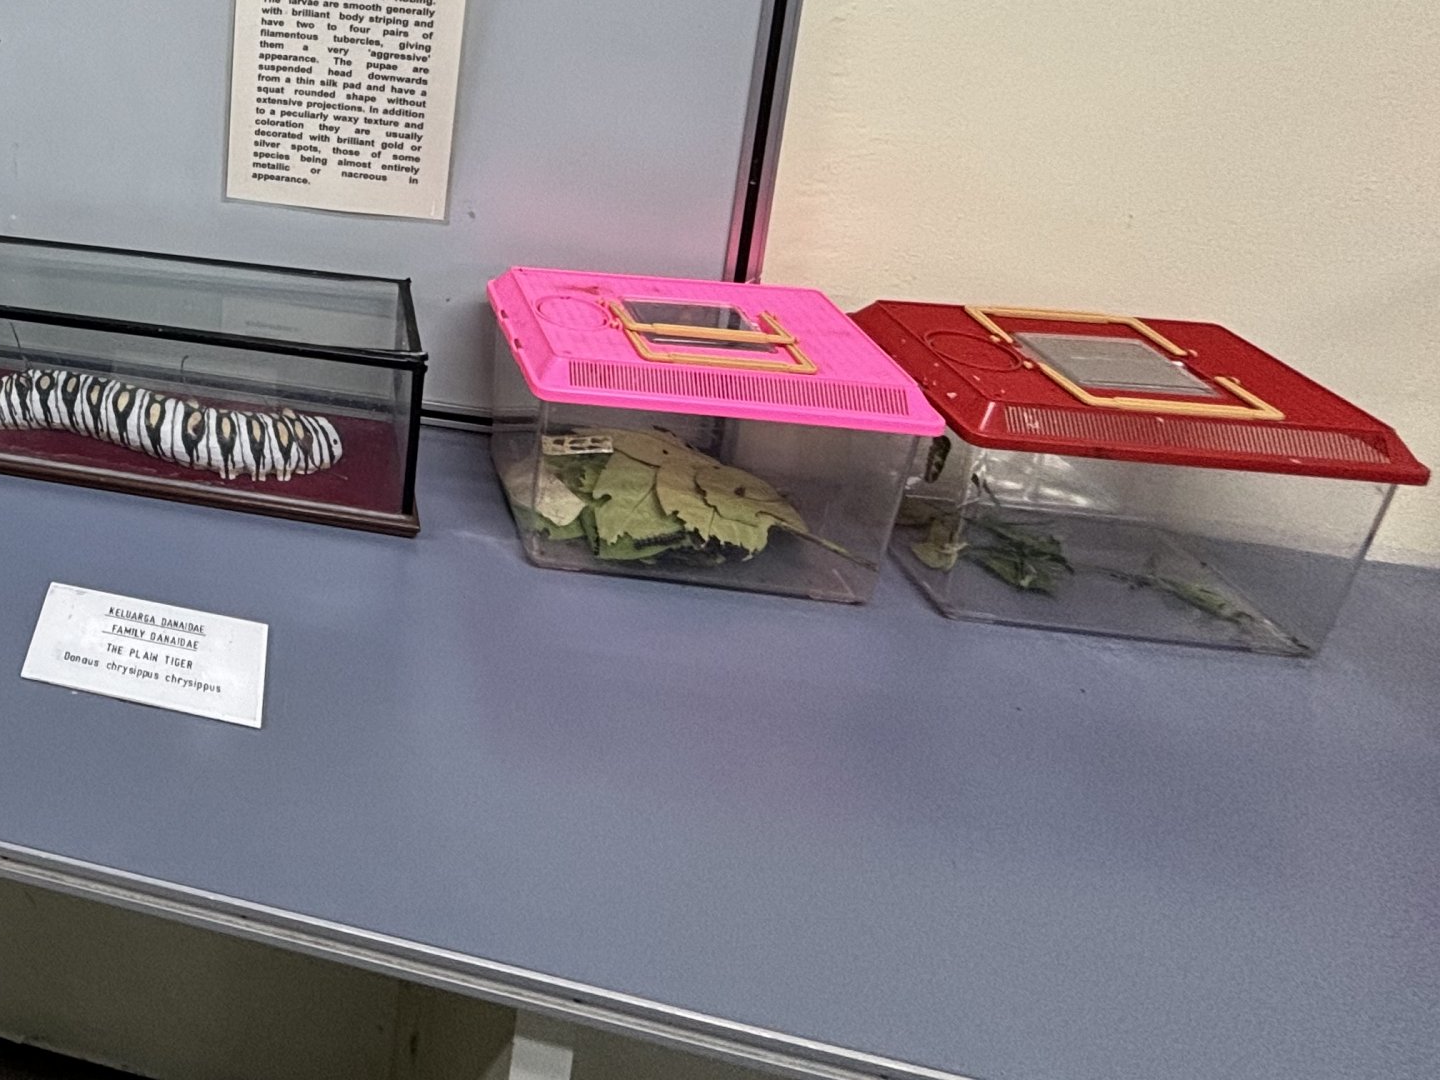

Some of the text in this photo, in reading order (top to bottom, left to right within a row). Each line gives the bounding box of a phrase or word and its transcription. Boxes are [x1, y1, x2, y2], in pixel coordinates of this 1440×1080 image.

[261, 6, 434, 28] with brilliant body striping and
[322, 0, 339, 8] are
[342, 2, 382, 11] smooth
[385, 6, 435, 18] generally
[260, 17, 433, 39] have two to four pairs of
[259, 40, 284, 49] them
[327, 46, 349, 57] very
[367, 48, 430, 62] 'aggressive'
[260, 28, 431, 53] filamentous tubercles, giving
[258, 52, 429, 74] appearance. The pupae are
[258, 63, 427, 85] suspended head downwards
[257, 73, 280, 82] from
[295, 76, 314, 85] thin
[319, 79, 337, 87] silk
[342, 81, 361, 90] pad
[366, 84, 385, 92] and
[390, 84, 415, 95] have
[256, 85, 426, 108] squat rounded shape without
[256, 96, 424, 118] extensive projections. In addition
[255, 106, 265, 114] to
[279, 110, 328, 121] peculiarly
[332, 114, 359, 124] waxy
[363, 116, 399, 127] texture
[254, 118, 423, 142] coloration they are usually
[254, 128, 303, 140] decorated
[308, 133, 330, 142] with
[336, 135, 374, 147] brilliant
[380, 141, 404, 150] gold
[253, 139, 420, 162] silver spots, those of some
[252, 161, 290, 171] metallic
[341, 170, 387, 181] nacreous
[408, 176, 418, 184] in
[253, 151, 419, 175] species being almost entirely
[251, 172, 310, 184] appearance.
[109, 607, 205, 633] KELUARGA DANAIDAE
[112, 624, 199, 650] FAMILY DANAIDAE
[107, 643, 193, 669] THE PLAIN TIGER
[106, 661, 159, 680] chrysippus
[165, 674, 221, 693] chrysippus
